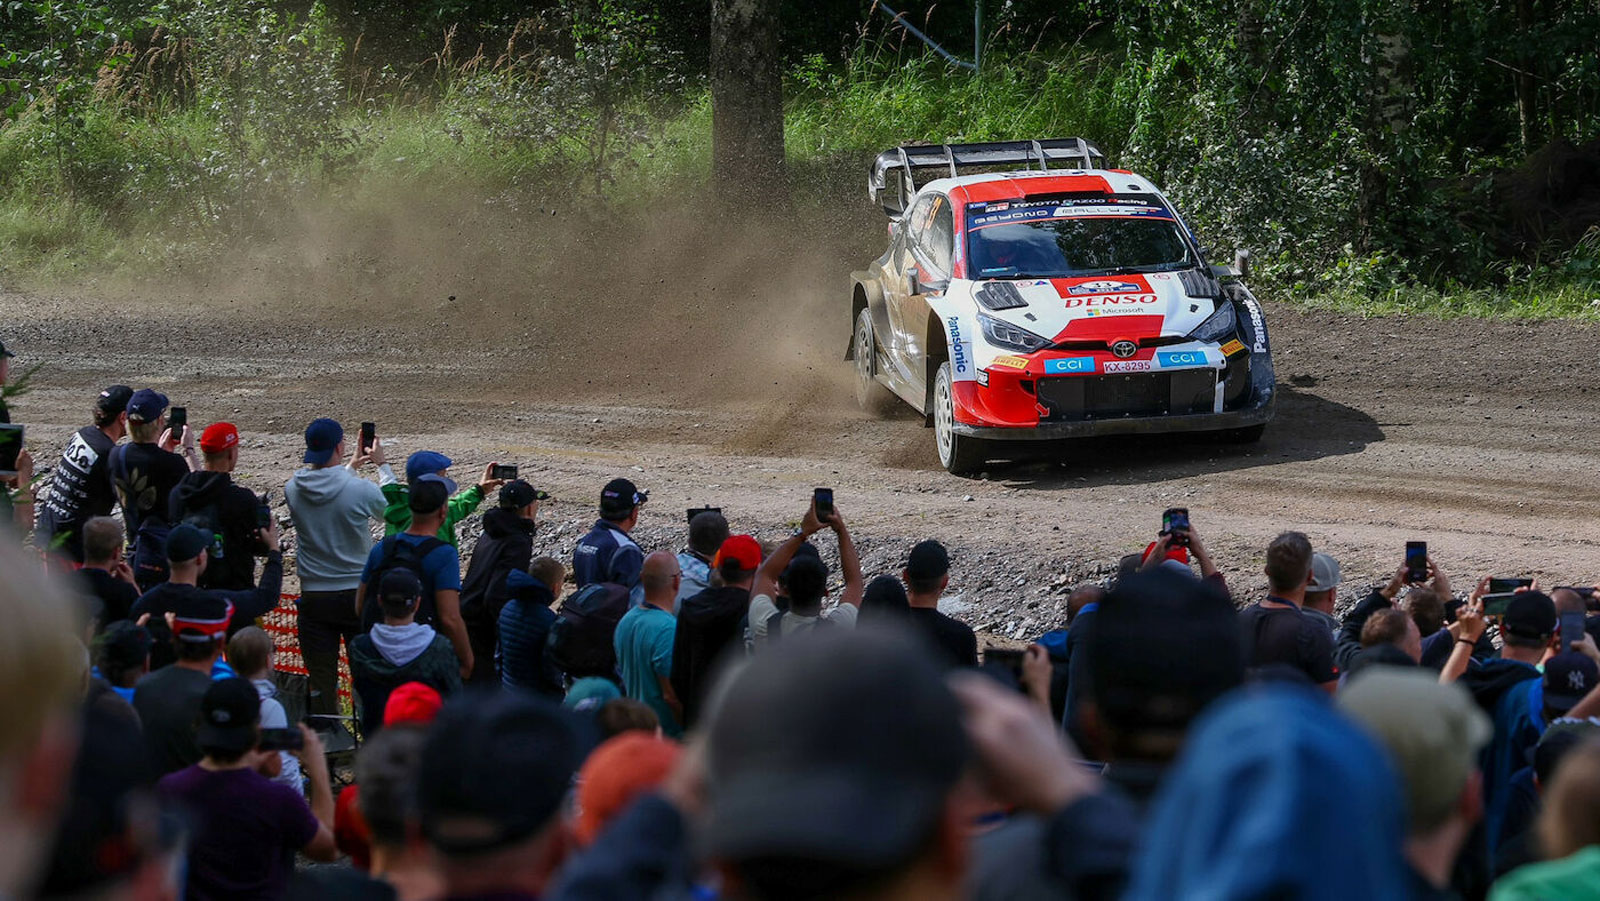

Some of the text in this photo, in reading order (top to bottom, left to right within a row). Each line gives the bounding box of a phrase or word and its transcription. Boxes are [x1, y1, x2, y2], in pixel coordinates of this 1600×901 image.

[1012, 200, 1059, 208] TOYOTA
[974, 209, 1048, 224] BEYOND
[1065, 294, 1157, 308] DENSO
[947, 315, 969, 373] Panasonic
[1169, 354, 1196, 363] CCI
[1056, 360, 1082, 370] CCI
[1105, 361, 1151, 371] KX-8295
